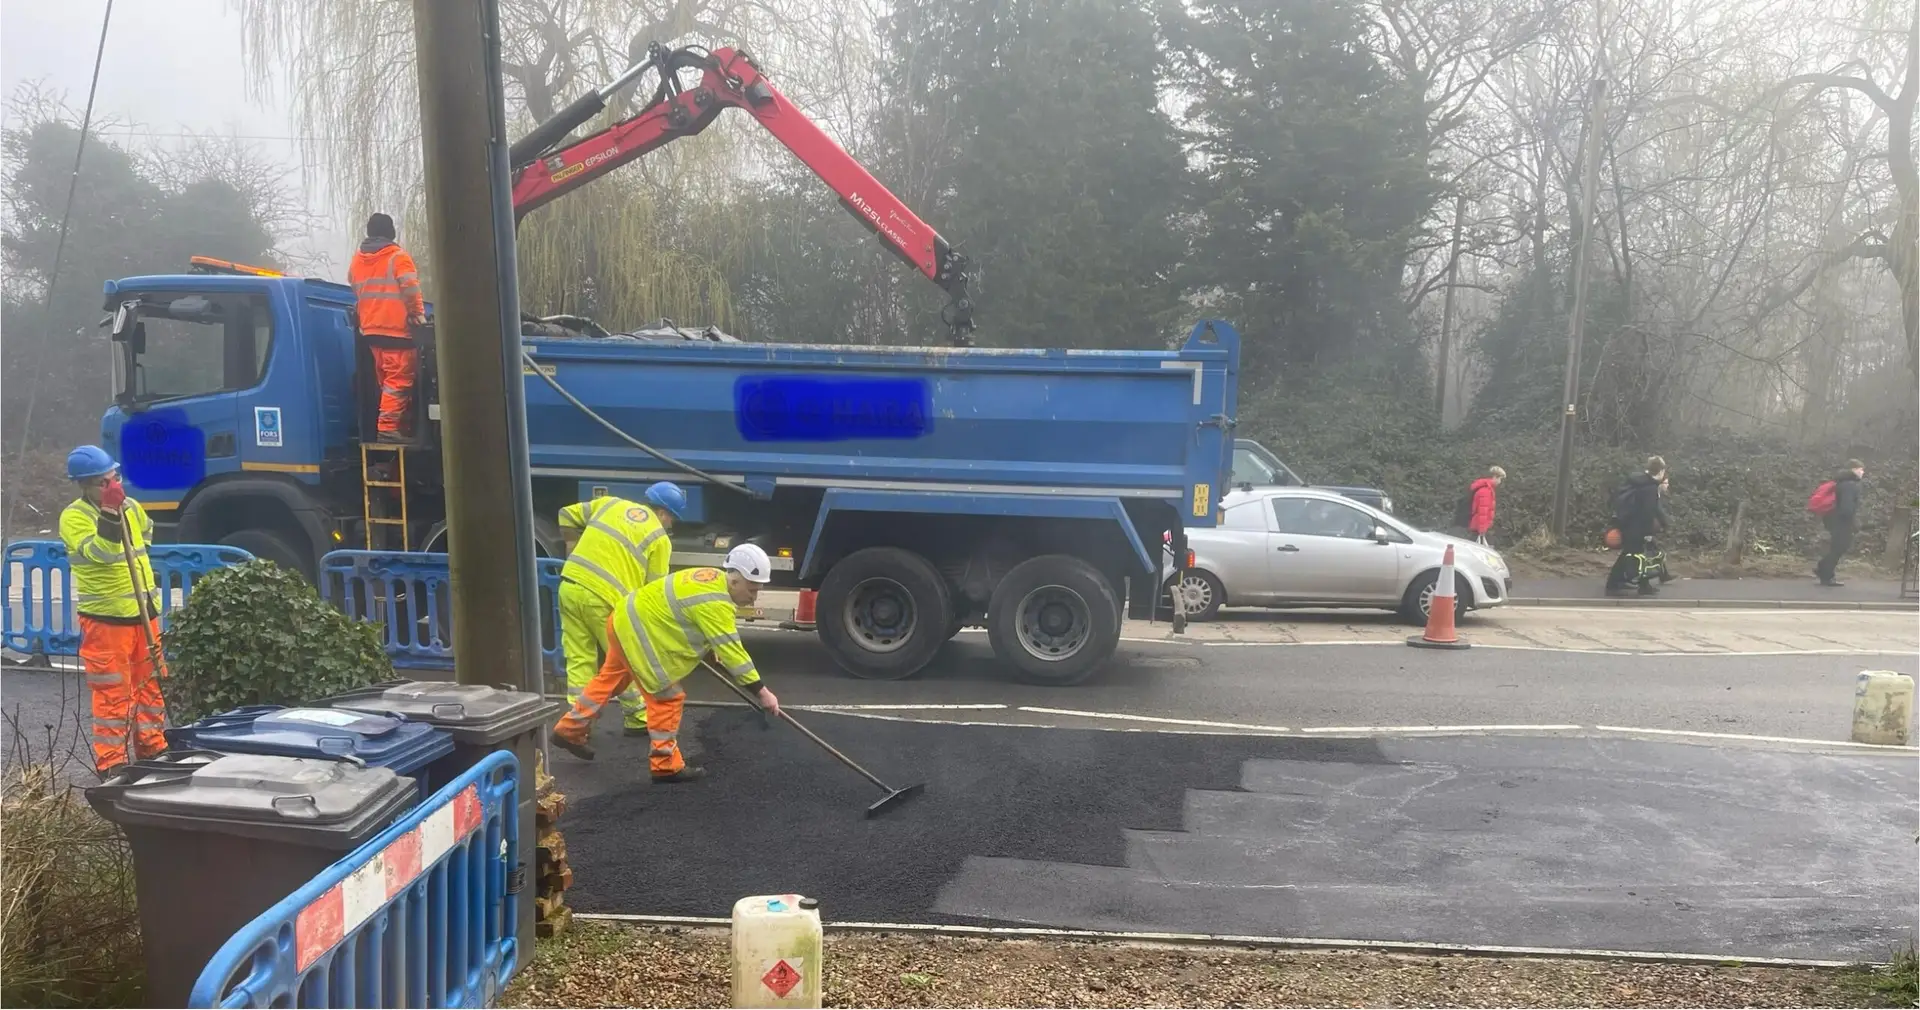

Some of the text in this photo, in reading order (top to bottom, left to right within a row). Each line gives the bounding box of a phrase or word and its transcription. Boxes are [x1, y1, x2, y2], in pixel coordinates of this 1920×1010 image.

[552, 146, 618, 181] PALFINGER EPSILON
[880, 222, 907, 248] CLASSIC
